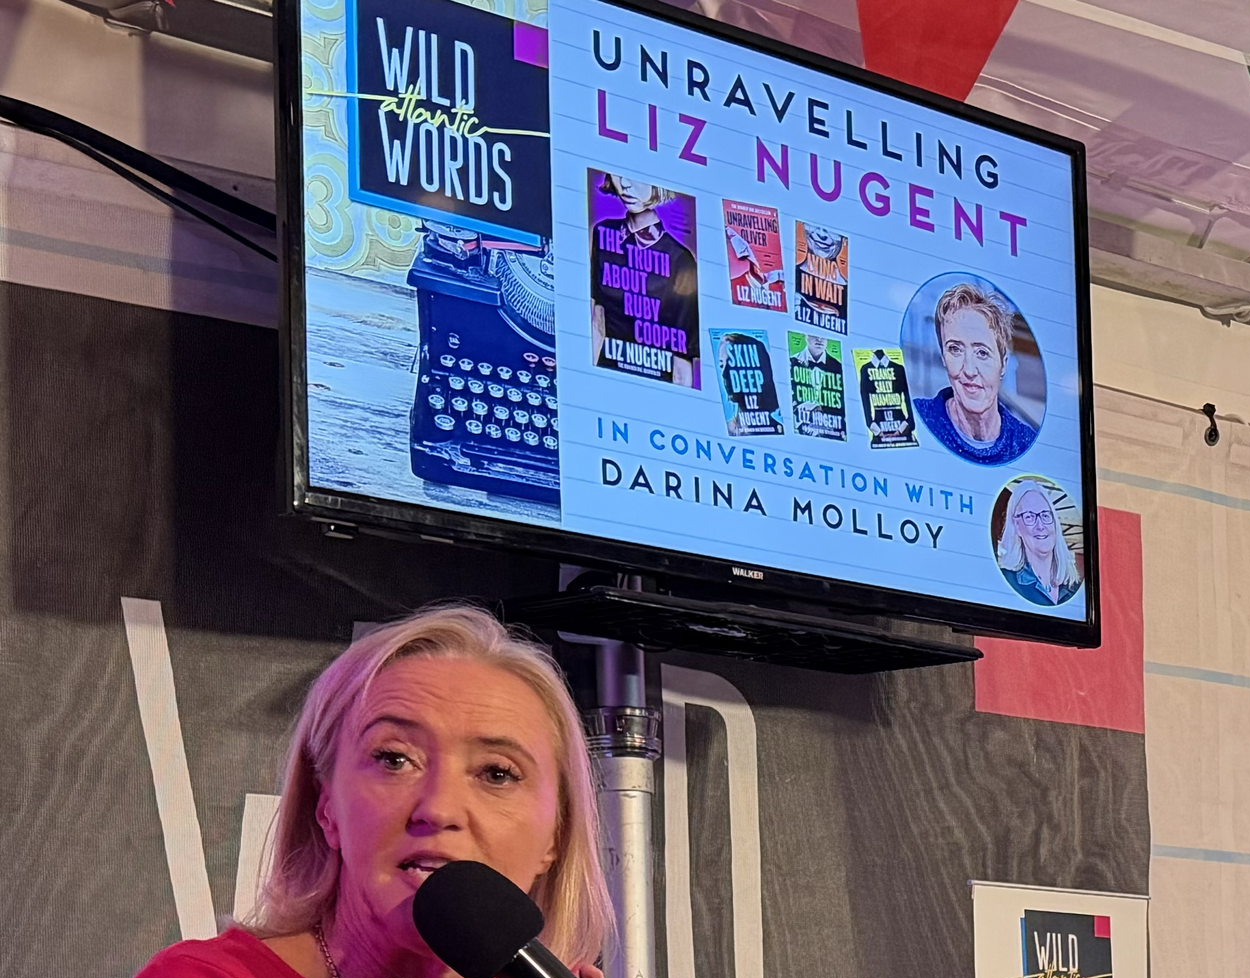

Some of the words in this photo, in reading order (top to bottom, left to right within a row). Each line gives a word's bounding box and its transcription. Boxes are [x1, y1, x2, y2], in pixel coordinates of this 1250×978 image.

[376, 16, 475, 111] WILD
[592, 29, 1000, 190] UNRAVELLING
[378, 108, 513, 212] WORDS
[596, 88, 708, 166] LIZ
[756, 135, 1028, 257] NUGENT
[726, 210, 778, 233] UNRAVELLING
[598, 226, 624, 254] THE
[741, 229, 767, 247] OLIVER
[626, 243, 671, 278] TRUTH
[806, 253, 838, 281] LYING
[602, 262, 648, 295] ABOUT
[801, 273, 813, 297] IN
[815, 278, 844, 306] WAIT
[624, 292, 661, 322] RUBY
[736, 285, 750, 302] LIZ
[751, 288, 782, 308] NUGENT
[798, 307, 811, 323] LIZ
[634, 320, 688, 355] COOPER
[604, 337, 624, 362] LIZ
[626, 342, 673, 373] NUGENT
[725, 342, 761, 368] SKIN
[729, 369, 764, 393] DEEP
[794, 366, 811, 385] OUR
[867, 367, 896, 381] STRANGE
[874, 380, 893, 393] SALLY
[744, 394, 759, 410] LIZ
[871, 392, 901, 406] DIAMOND
[739, 411, 771, 426] NUGENT
[798, 406, 811, 424] LIZ
[812, 411, 842, 430] NUGENT
[884, 410, 894, 421] LIZ
[597, 417, 630, 444] IN
[650, 429, 890, 498] CONVERSATION
[905, 482, 974, 515] WITH
[601, 458, 768, 517] DARINA
[793, 499, 945, 549] MOLLOY
[732, 566, 764, 580] WALKER
[1034, 931, 1079, 972] WILD
